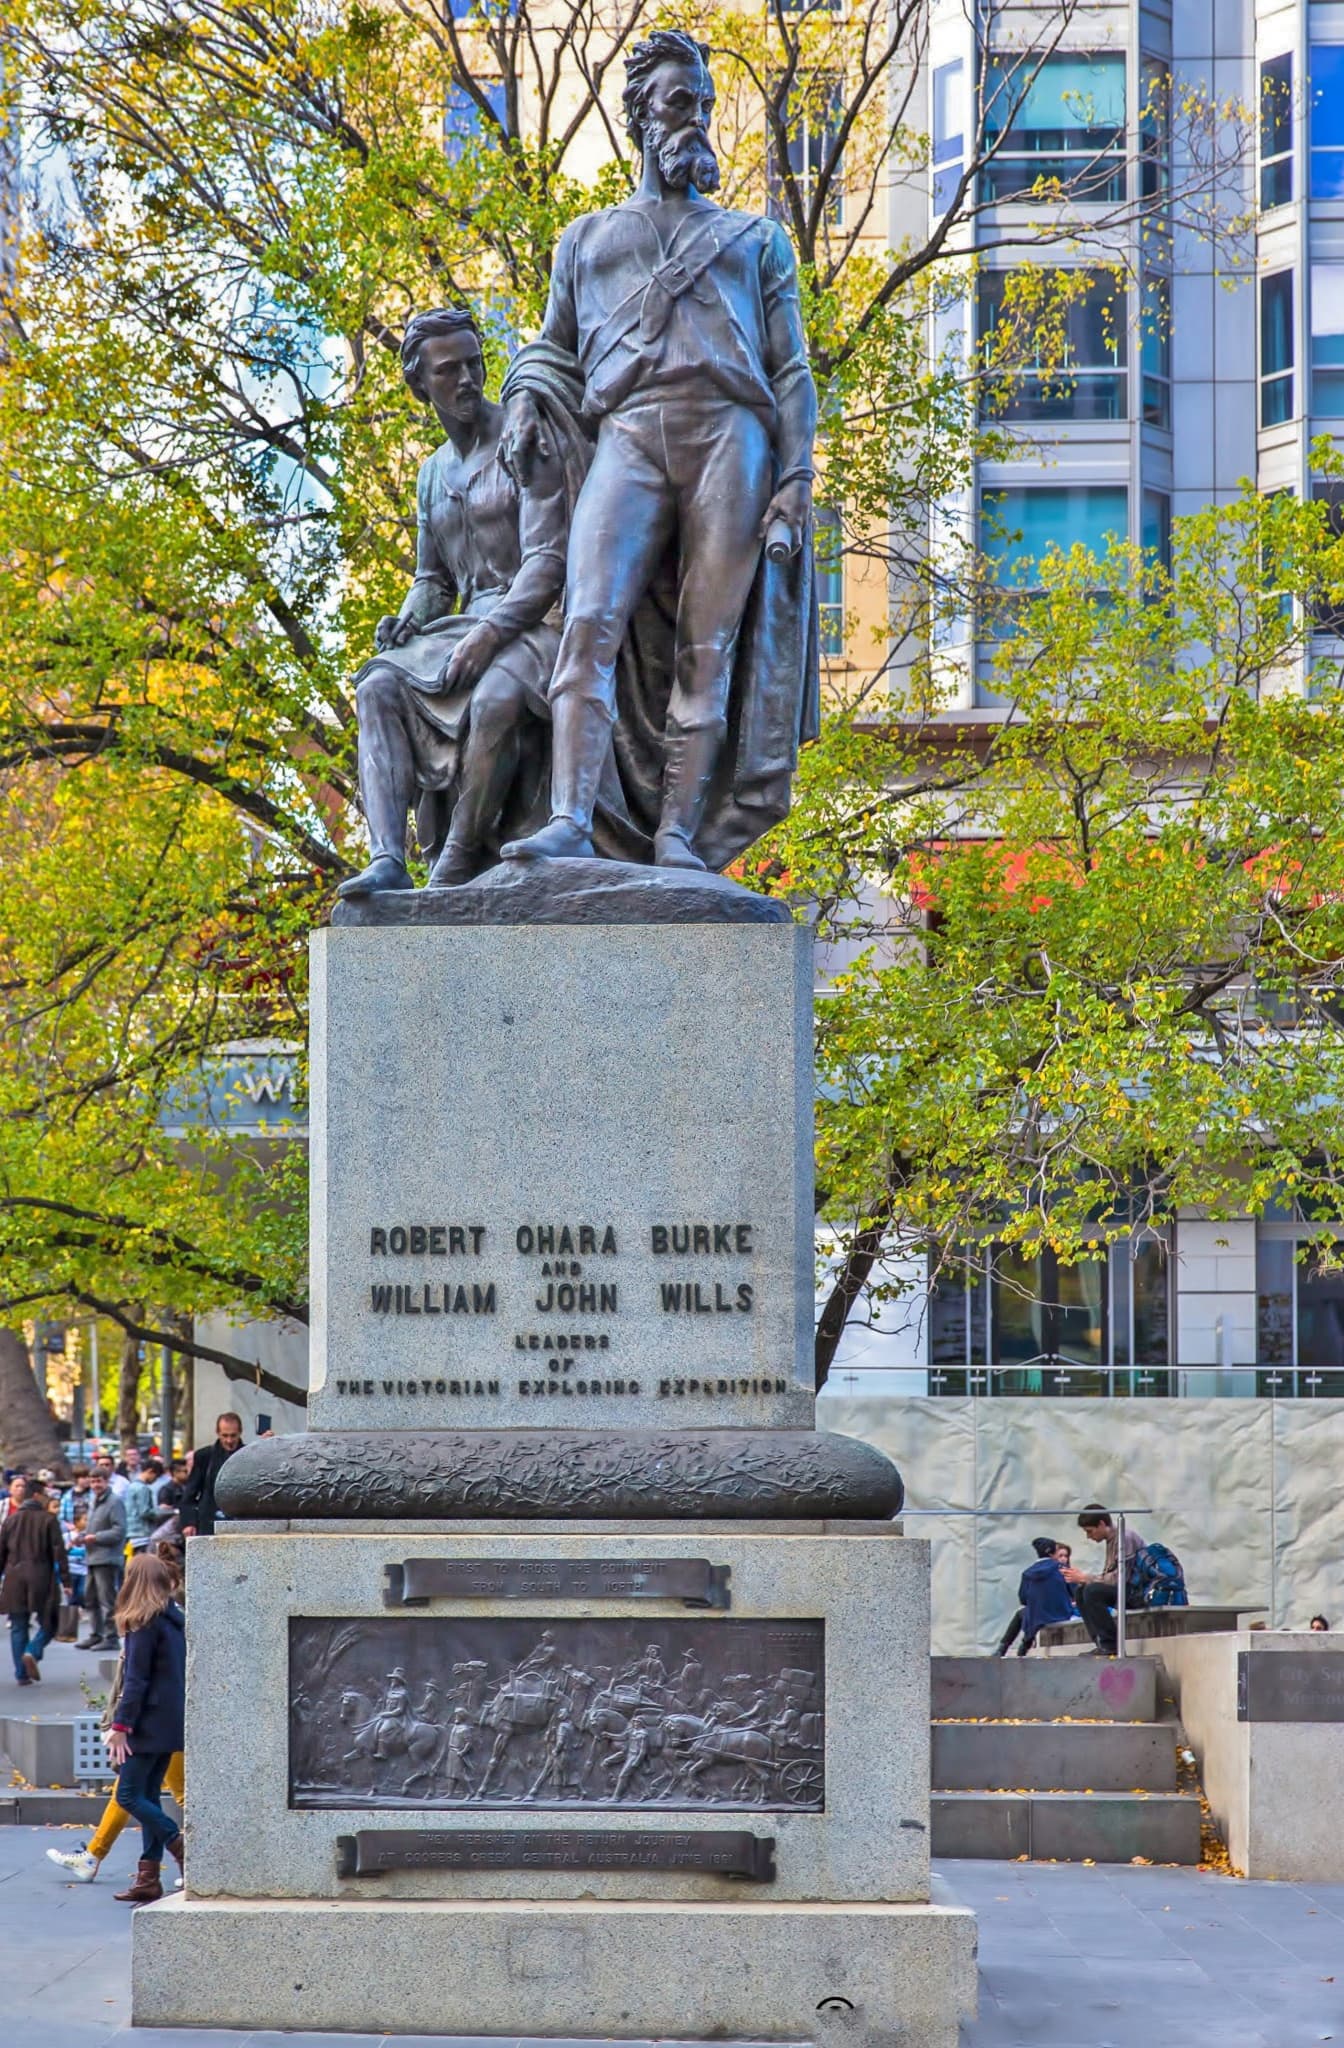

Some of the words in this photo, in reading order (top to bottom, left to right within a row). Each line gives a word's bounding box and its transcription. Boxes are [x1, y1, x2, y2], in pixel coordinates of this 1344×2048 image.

[370, 1226, 485, 1255] ROBERT
[516, 1225, 617, 1254] OHARA
[651, 1225, 753, 1254] BURKE
[541, 1261, 582, 1276] AND
[371, 1283, 496, 1314] WILLIAM
[536, 1283, 617, 1313] JOHN
[660, 1283, 753, 1312] WILLS
[515, 1335, 610, 1350] LEADERS
[549, 1358, 575, 1373] OF
[336, 1380, 374, 1396] THE
[382, 1380, 500, 1396] VICTORIAN
[518, 1380, 640, 1396] EXPLORING
[660, 1379, 787, 1396] EXPEDITION
[447, 1563, 481, 1576] FIRST
[493, 1563, 508, 1575] TO
[519, 1563, 559, 1575] CROSS
[568, 1563, 592, 1574] THE
[600, 1563, 667, 1575] CONTINENT
[471, 1581, 504, 1593] FROM
[520, 1581, 560, 1593] SOUTH
[572, 1581, 588, 1593] TO
[605, 1581, 643, 1593] NORTH
[418, 1834, 449, 1845] THEY
[457, 1834, 517, 1845] PERISHED
[523, 1834, 541, 1846] ON
[545, 1834, 570, 1845] THE
[577, 1834, 627, 1846] RETURN
[634, 1834, 692, 1846] JOURNEY
[522, 1852, 579, 1863] CENTRAL
